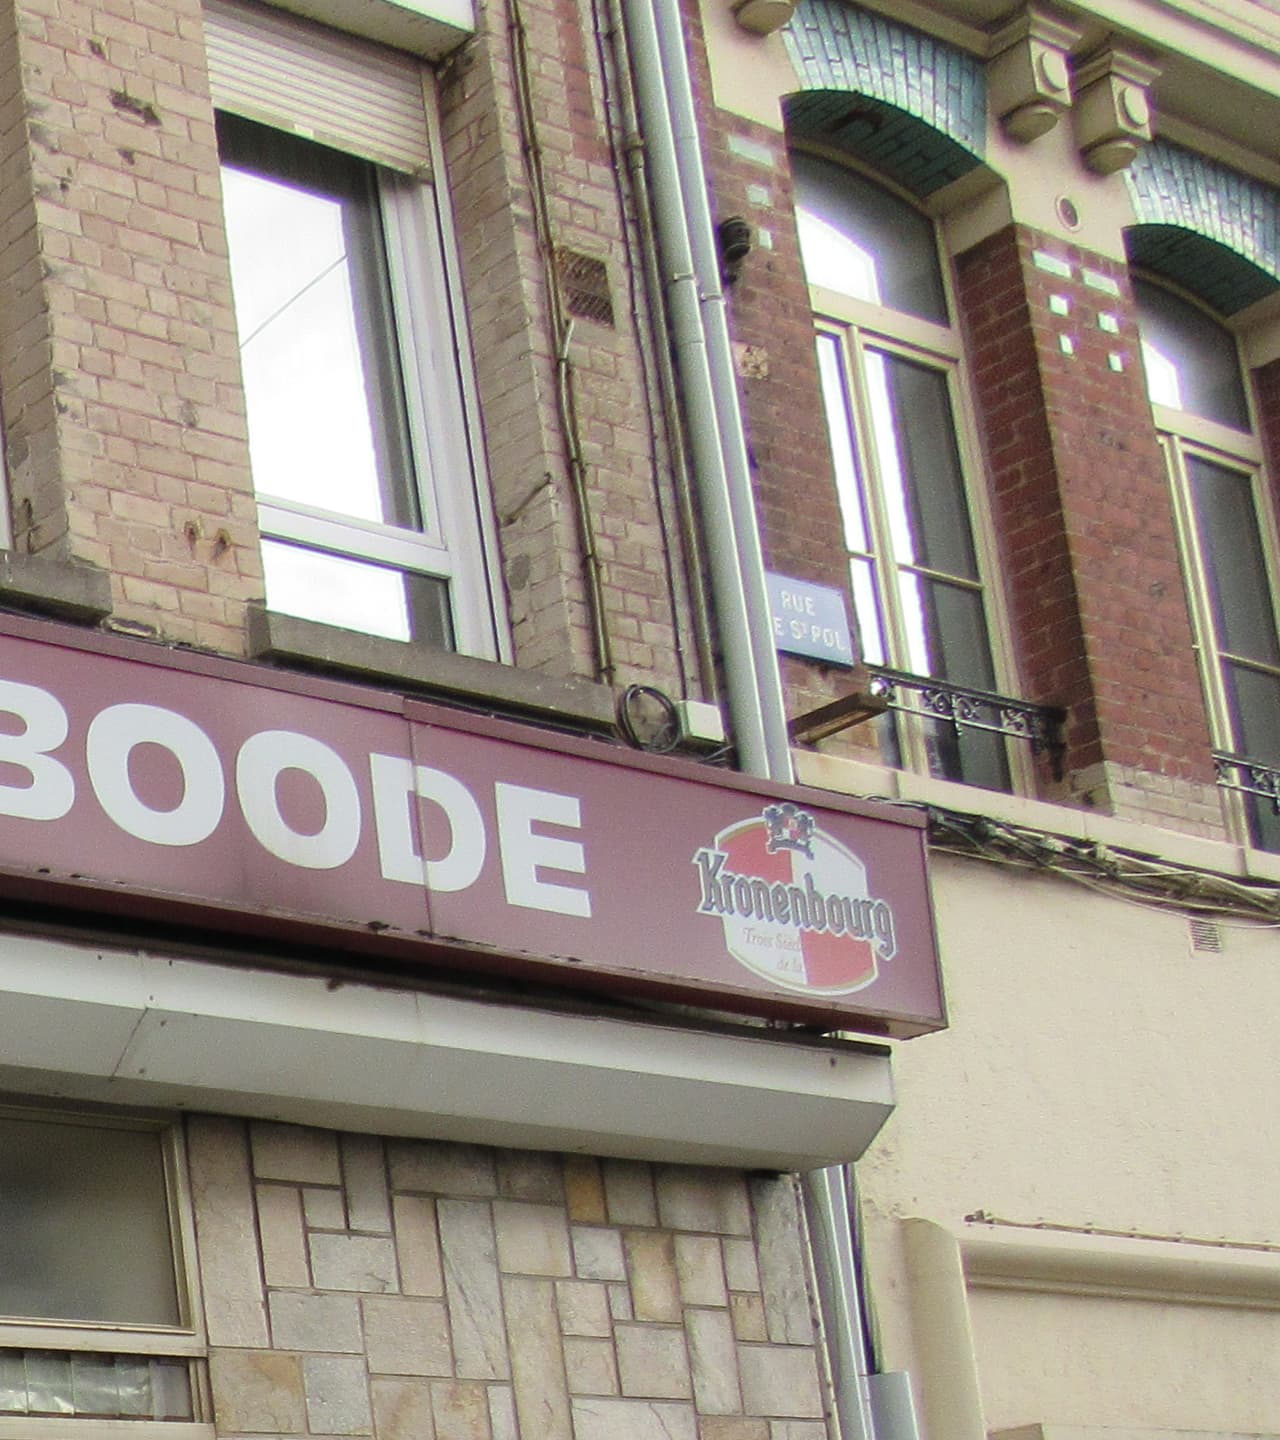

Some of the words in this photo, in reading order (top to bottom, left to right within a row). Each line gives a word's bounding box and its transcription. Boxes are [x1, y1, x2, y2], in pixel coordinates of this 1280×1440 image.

[780, 589, 816, 616] RUE
[811, 624, 847, 651] POL
[696, 850, 894, 959] Kronenbourg
